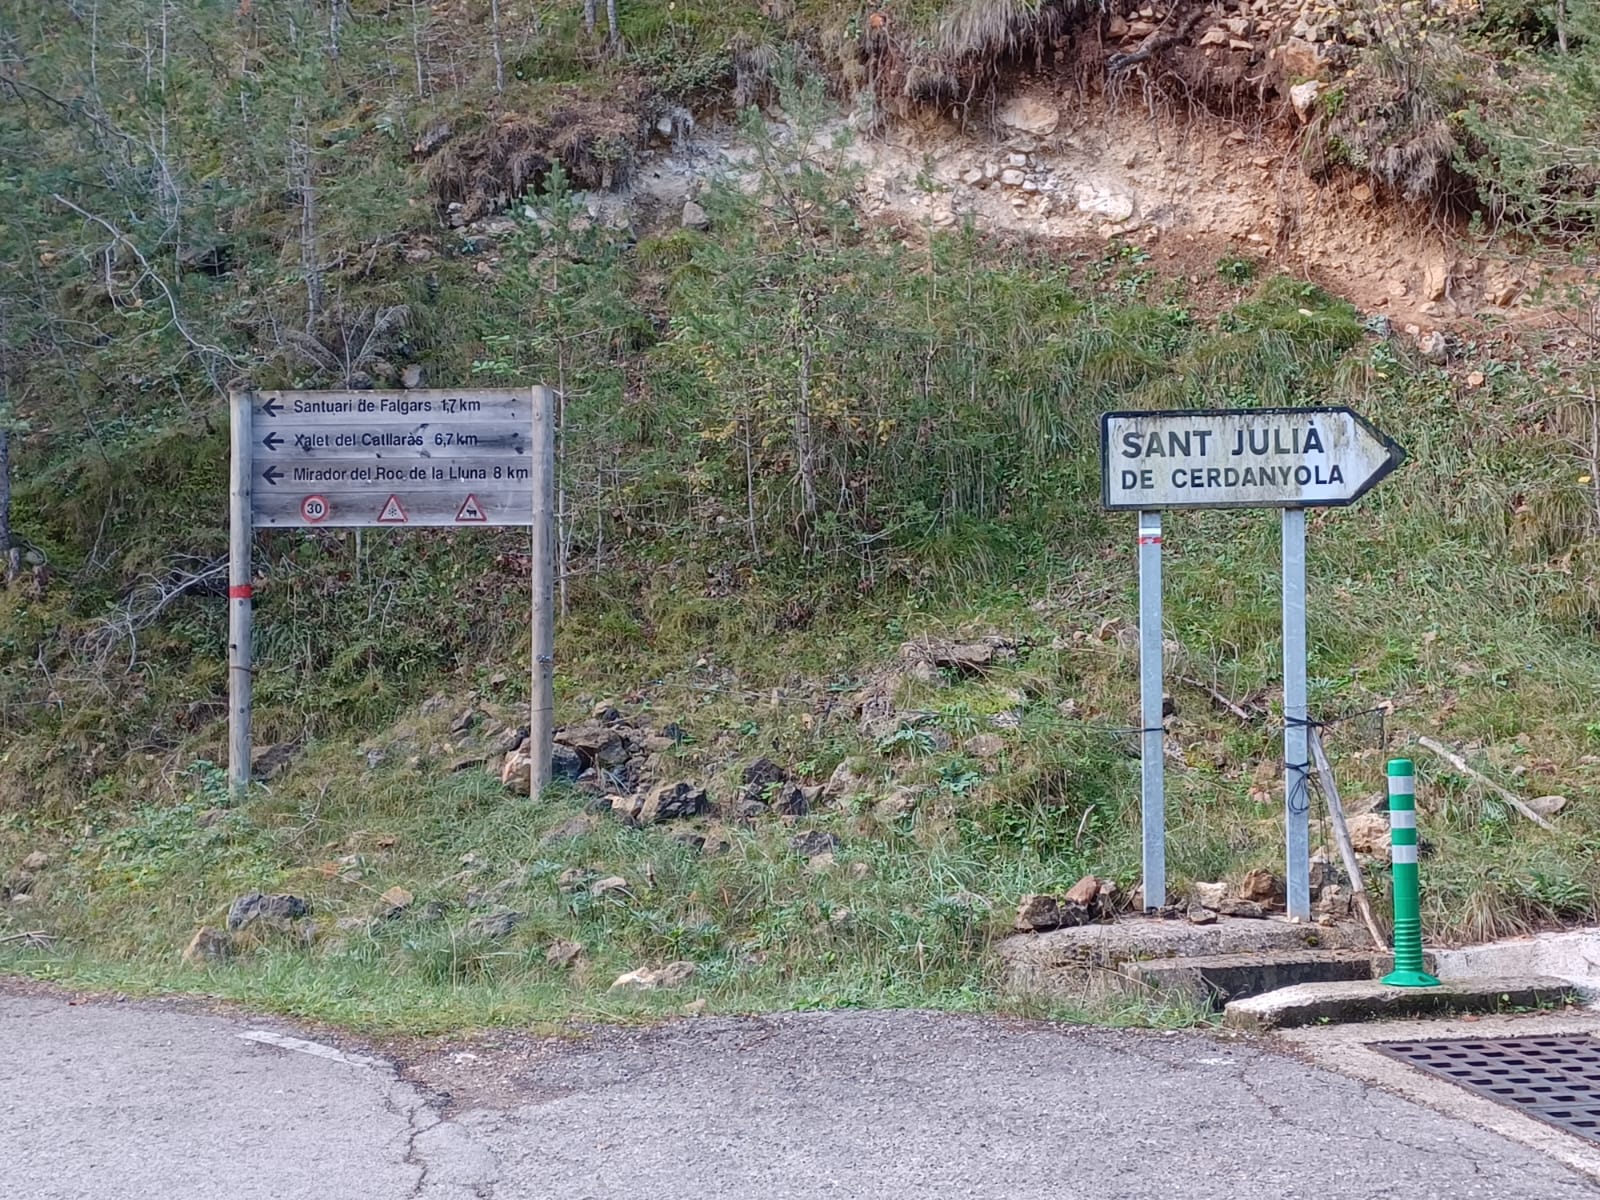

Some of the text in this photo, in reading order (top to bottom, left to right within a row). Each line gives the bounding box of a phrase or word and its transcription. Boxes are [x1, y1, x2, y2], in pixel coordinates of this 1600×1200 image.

[294, 398, 481, 415] Santuari de Falgars 1,7 km
[294, 432, 478, 448] Xalet del Catllaràs 6,7 km
[1122, 420, 1324, 459] SANT JULIÀ
[294, 466, 528, 481] Mirador del Roc de la Lluna 8 km
[1121, 464, 1345, 490] DE CERDANYOLA
[307, 503, 323, 514] 30
